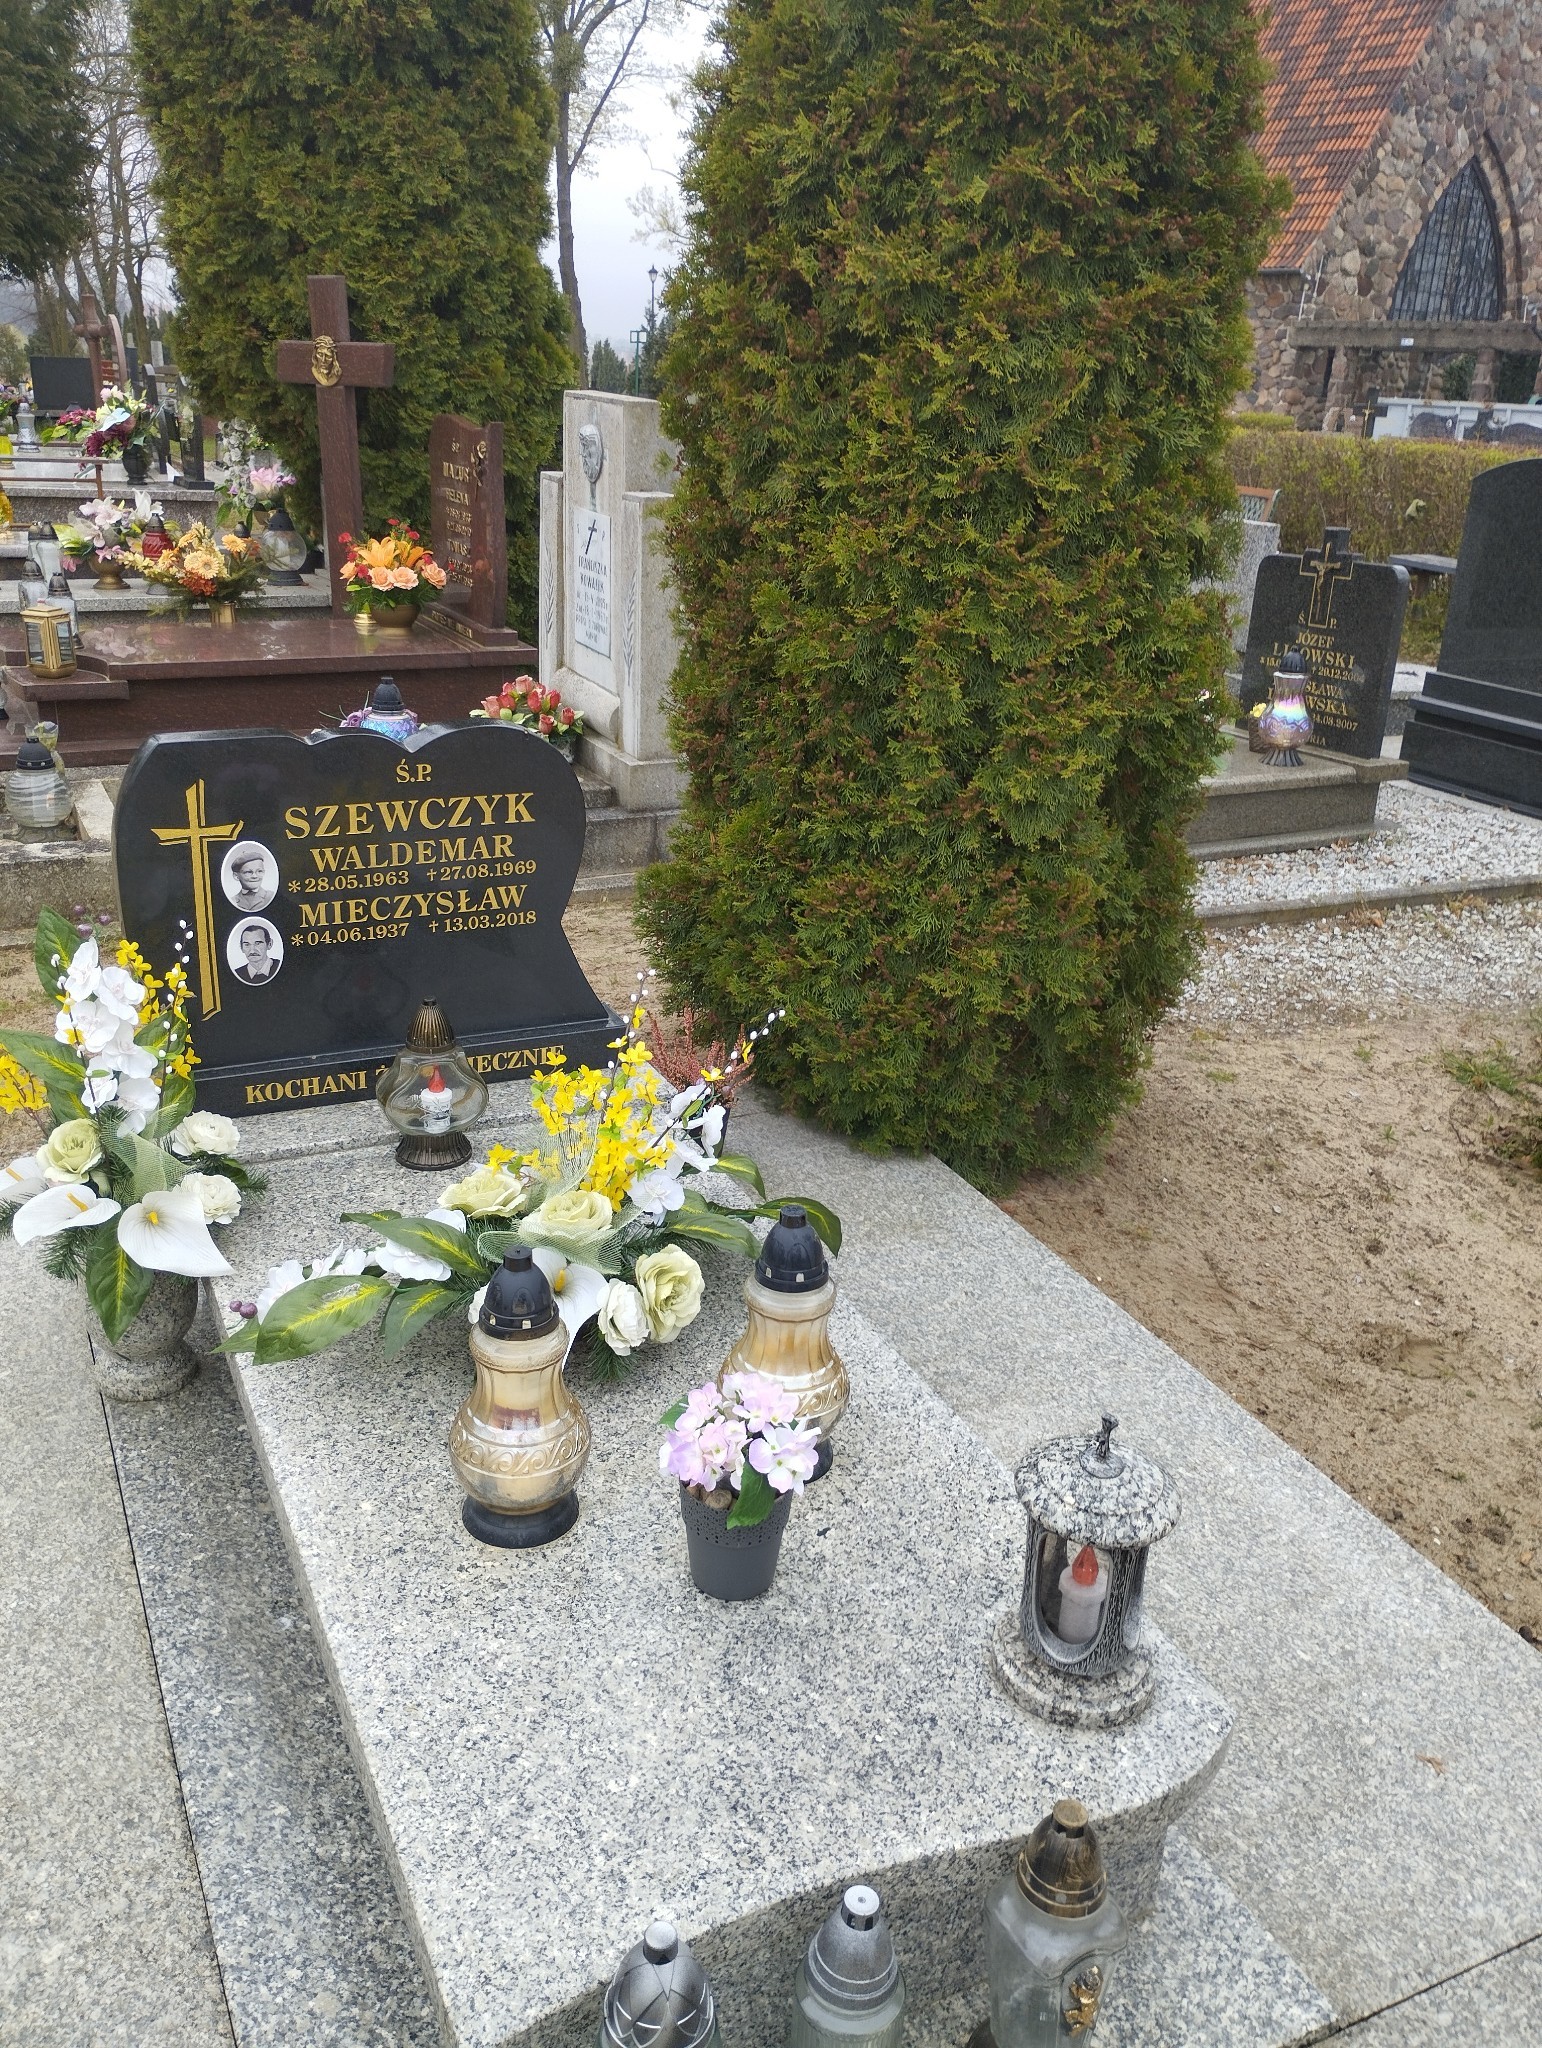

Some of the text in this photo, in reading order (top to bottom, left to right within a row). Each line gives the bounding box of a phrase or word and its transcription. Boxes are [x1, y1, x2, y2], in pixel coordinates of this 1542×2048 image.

[1273, 642, 1355, 669] LIOWSKI
[1295, 629, 1335, 649] JÓZEF
[284, 792, 535, 840] SZEWCZYK
[310, 834, 515, 873] WALDEMAR
[299, 884, 528, 928] MIECZYSŁAW
[245, 1070, 368, 1105] KOCHANI
